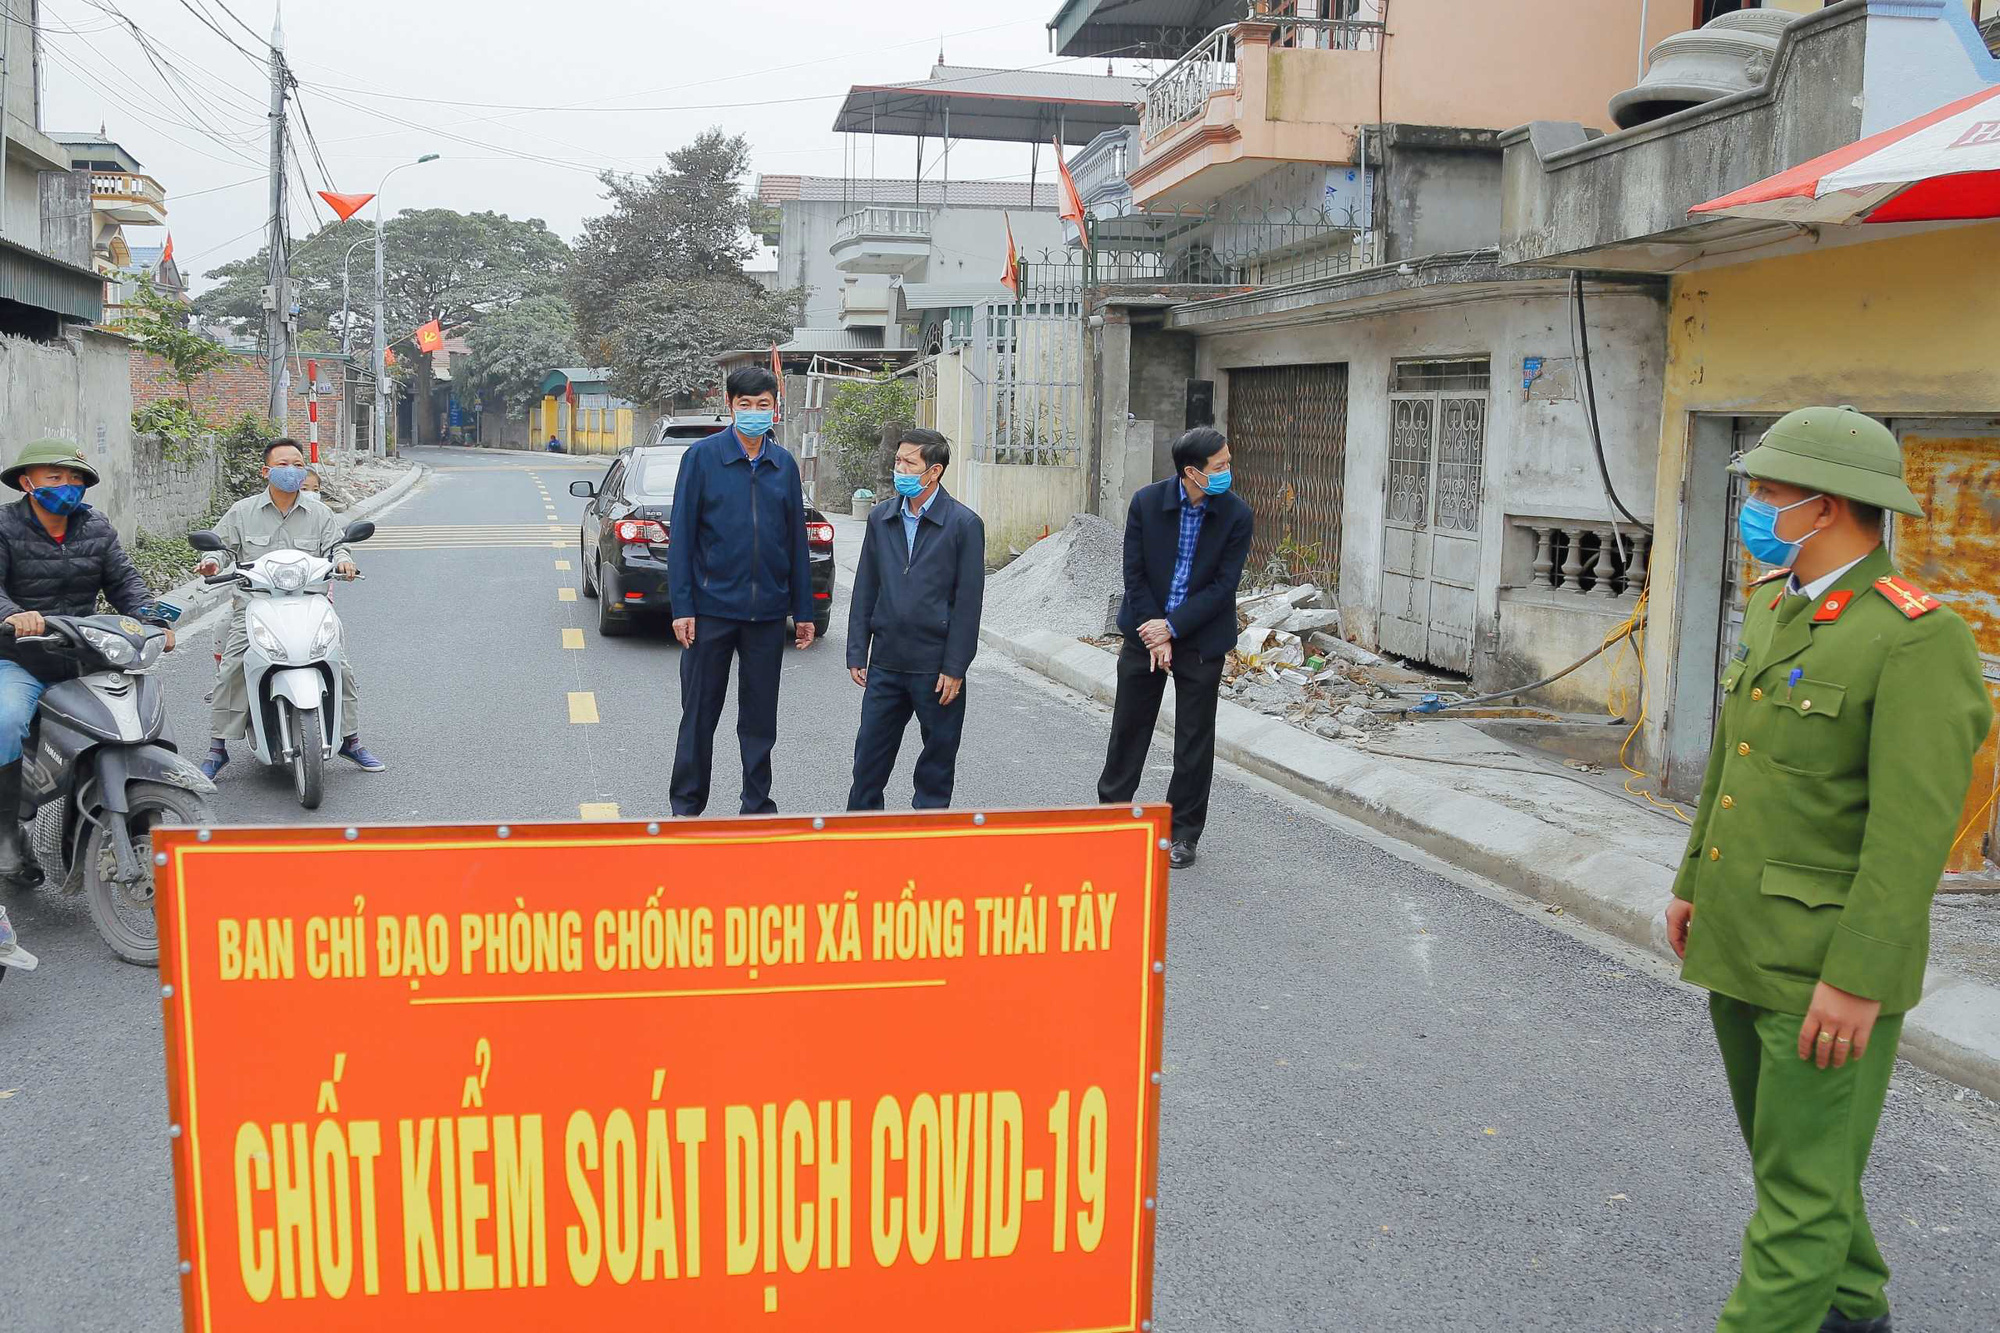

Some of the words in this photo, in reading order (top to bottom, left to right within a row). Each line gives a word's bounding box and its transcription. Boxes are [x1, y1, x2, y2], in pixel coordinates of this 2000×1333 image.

[218, 918, 294, 980] BAN
[306, 895, 366, 979] CHỈ
[376, 914, 450, 990] ĐẠO
[460, 897, 582, 974] PHÒNG
[594, 887, 714, 971] CHỐNG
[724, 903, 806, 980] DỊCH
[816, 891, 863, 963] XÃ
[872, 879, 965, 960] HỒNG
[975, 883, 1048, 956] THÁI
[1057, 880, 1118, 952] TÂY
[234, 1052, 382, 1302] CHỐT
[398, 1036, 547, 1299] KIỂM
[565, 1068, 707, 1287] SOÁT
[724, 1100, 852, 1313] DỊCH
[870, 1086, 1108, 1268] COVID-19
